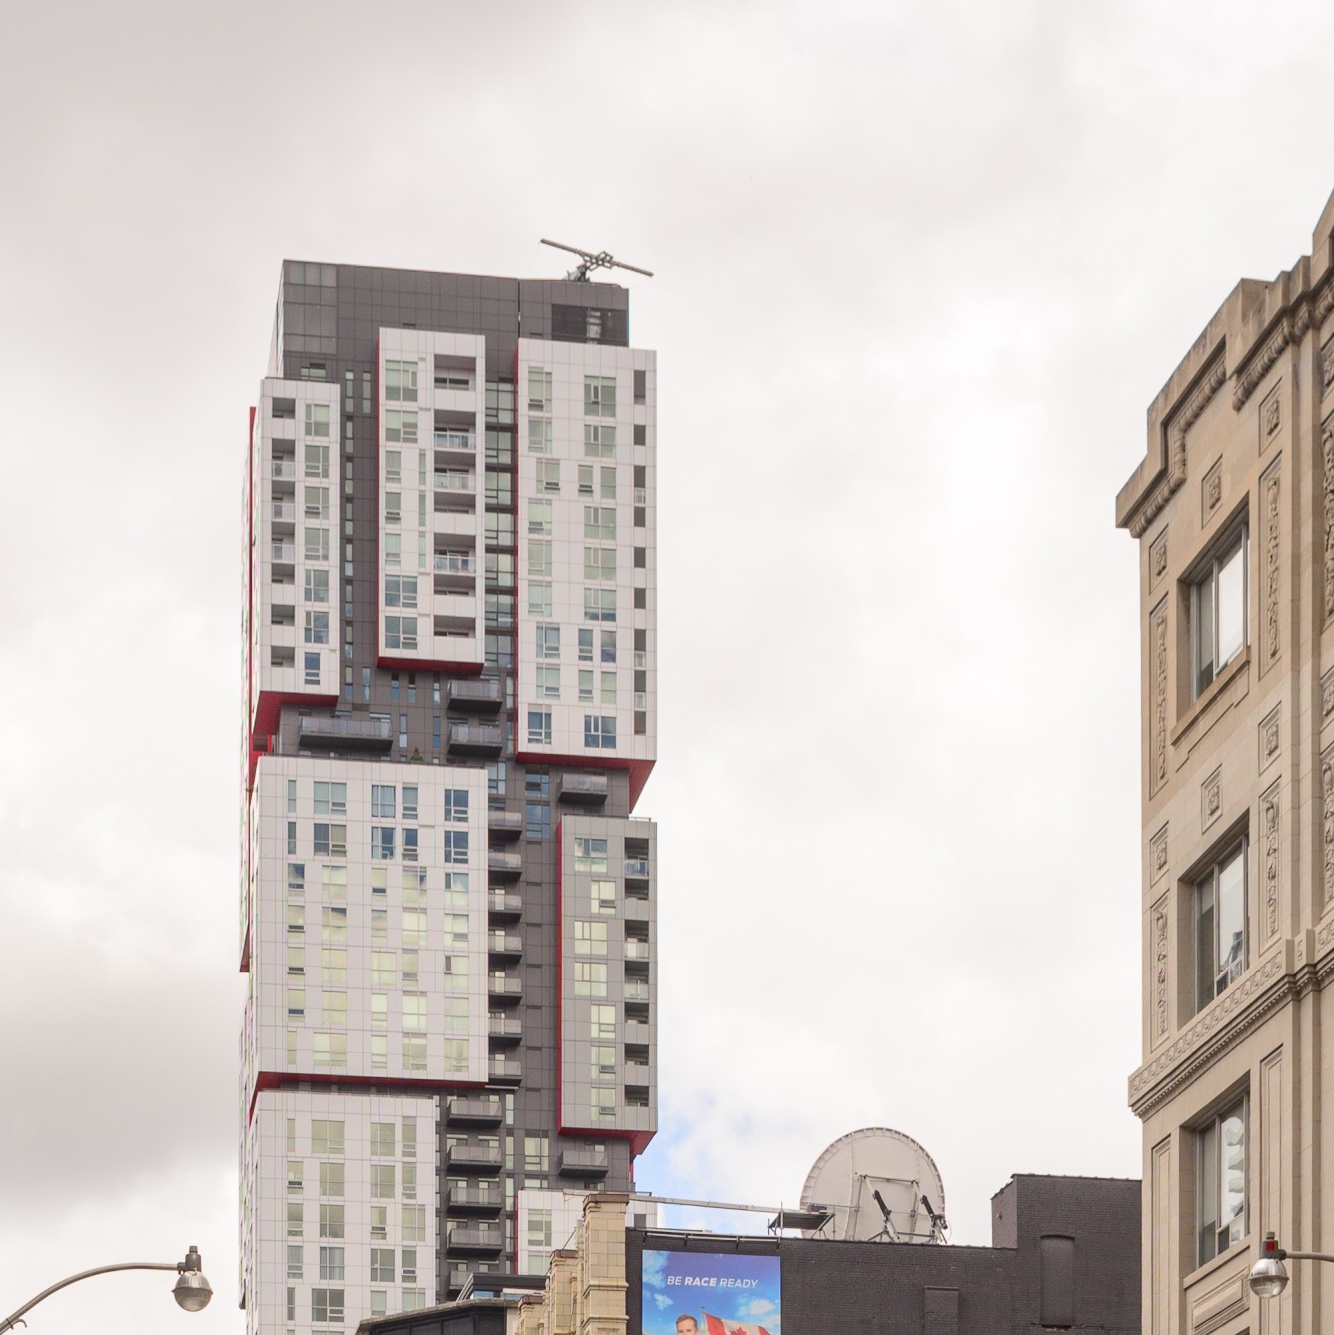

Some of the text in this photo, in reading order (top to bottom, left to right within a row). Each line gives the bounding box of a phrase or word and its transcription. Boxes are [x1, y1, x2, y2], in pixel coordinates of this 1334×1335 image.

[667, 1276, 759, 1288] BE RACE READY
